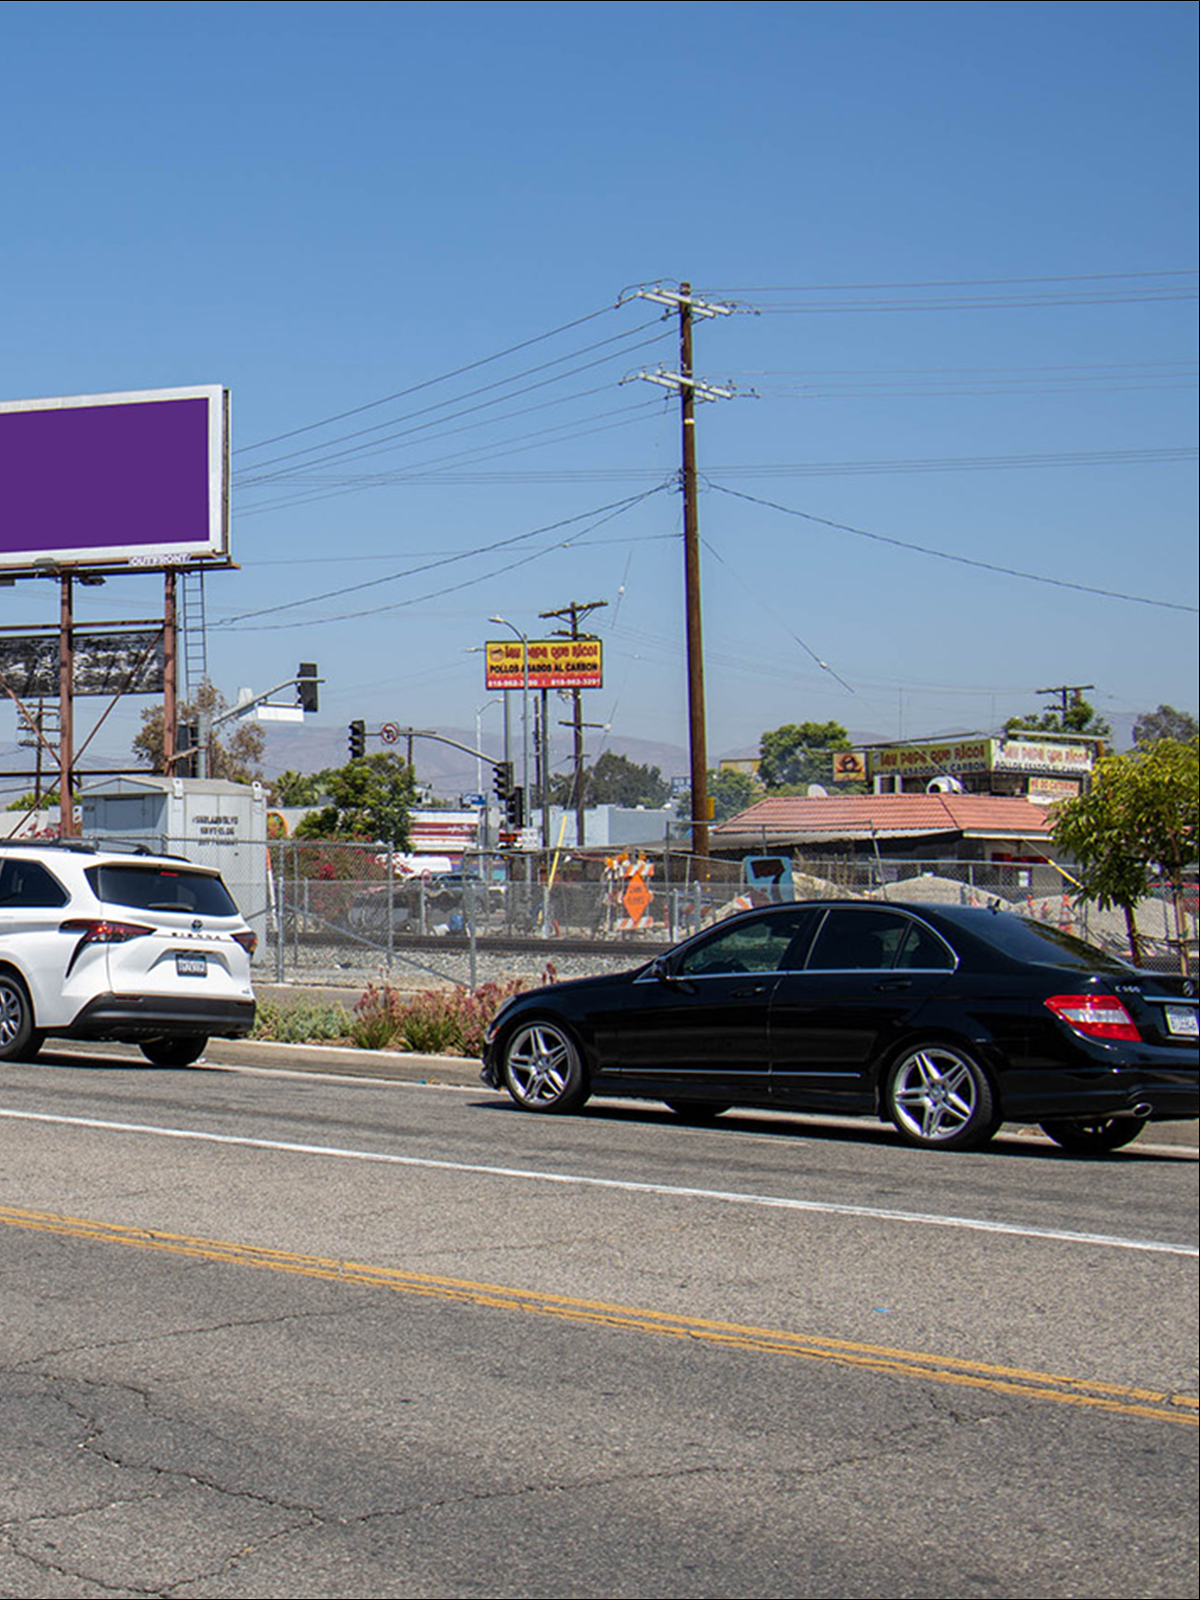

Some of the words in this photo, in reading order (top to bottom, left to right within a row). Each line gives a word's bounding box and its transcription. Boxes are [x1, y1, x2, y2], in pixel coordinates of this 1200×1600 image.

[490, 664, 519, 673] POLLOS
[554, 664, 564, 672] AL
[950, 761, 986, 771] CARBON
